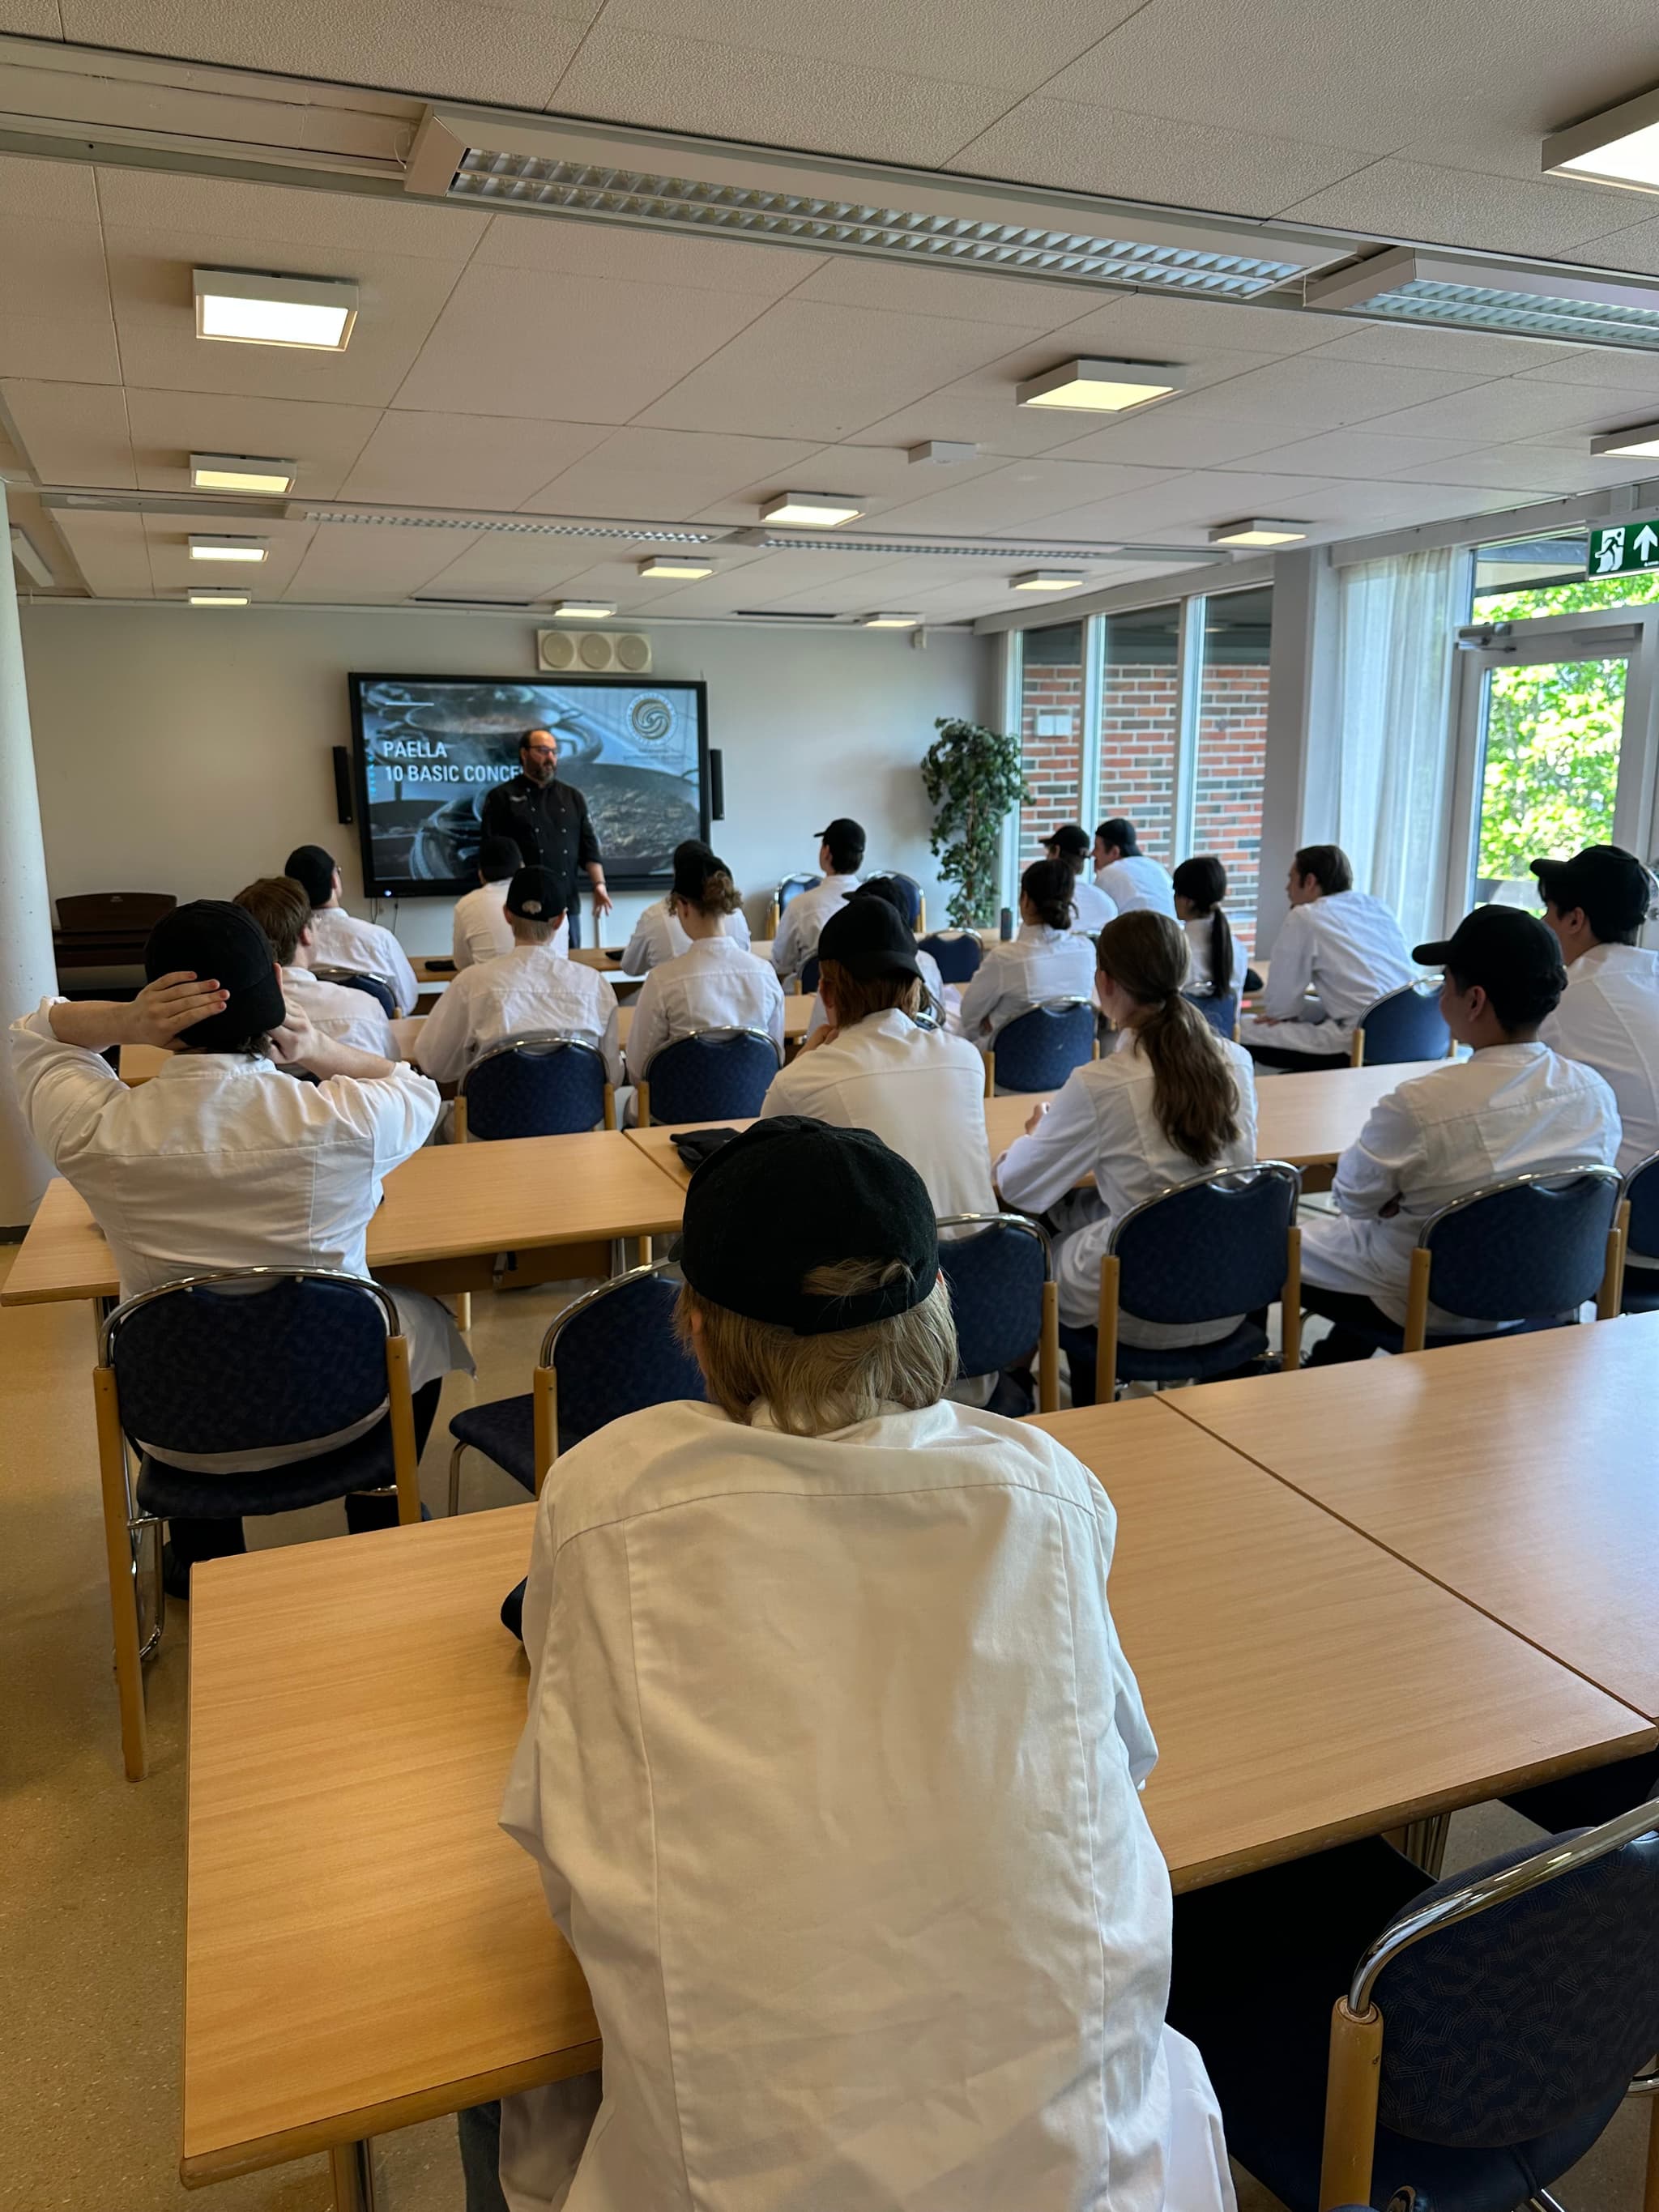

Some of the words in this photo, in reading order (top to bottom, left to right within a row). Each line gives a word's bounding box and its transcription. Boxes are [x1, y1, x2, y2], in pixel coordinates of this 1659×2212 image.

[383, 740, 448, 759] PAELLA
[385, 765, 403, 782] 10
[407, 765, 459, 782] BASIC
